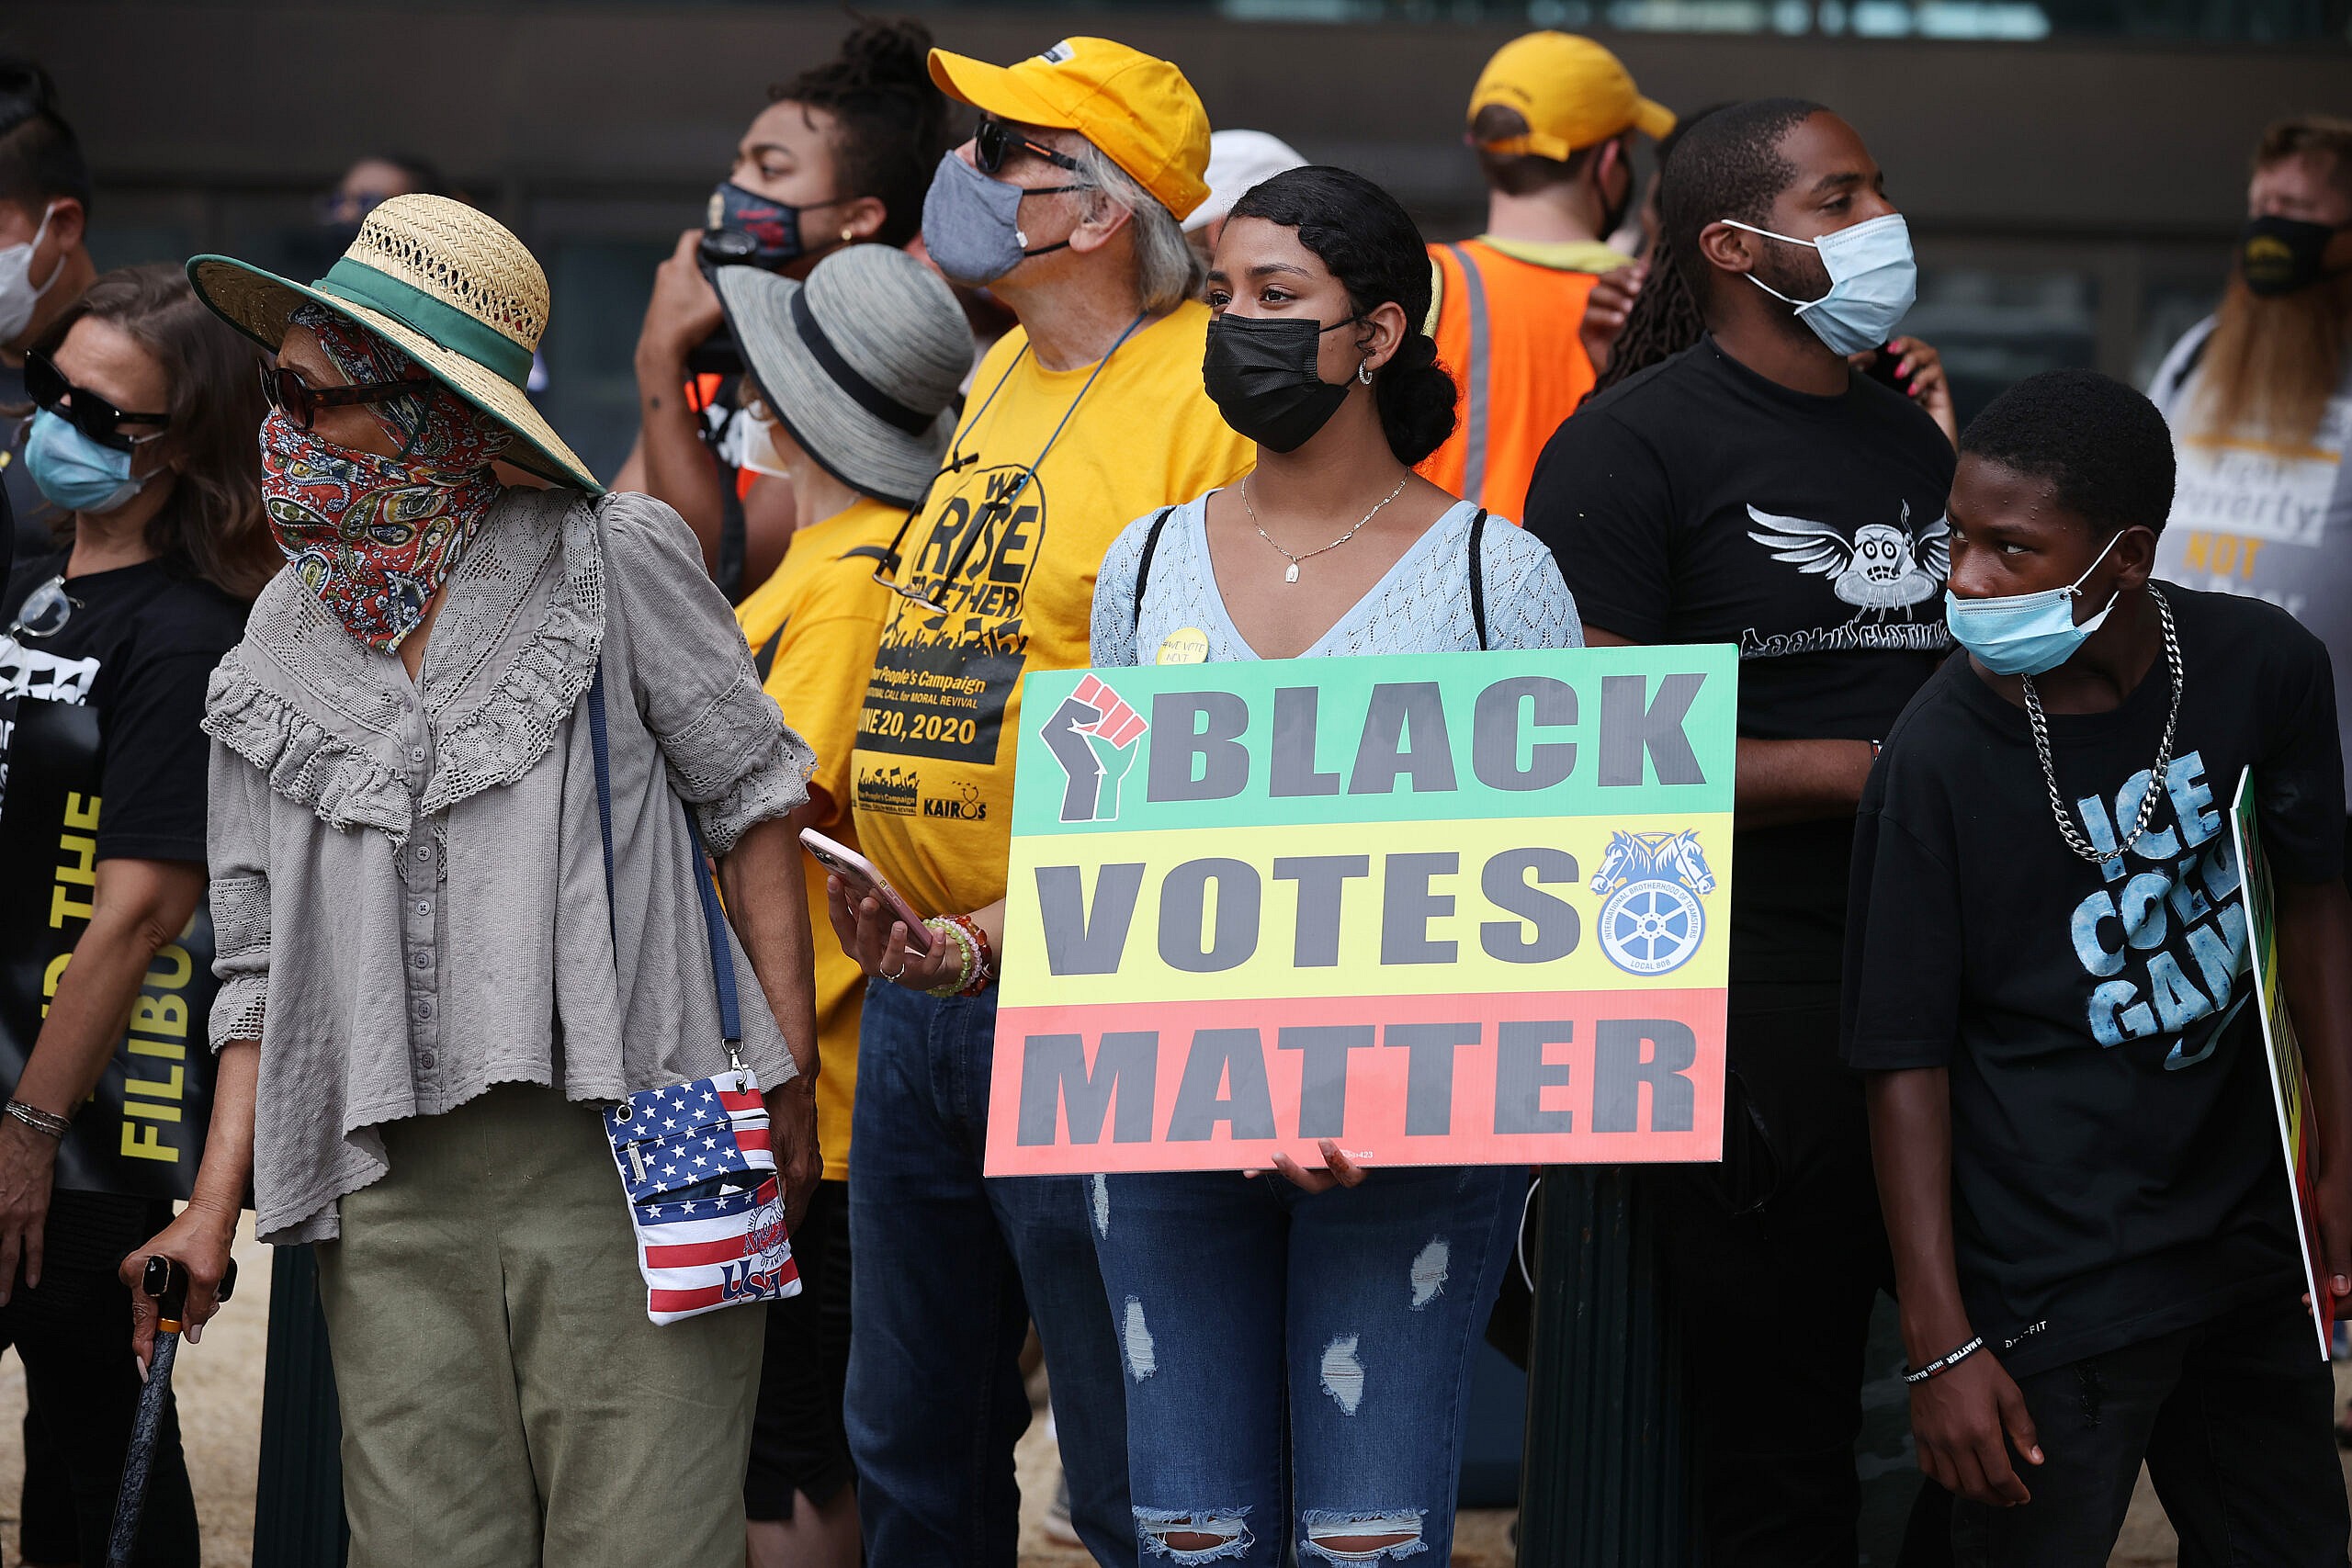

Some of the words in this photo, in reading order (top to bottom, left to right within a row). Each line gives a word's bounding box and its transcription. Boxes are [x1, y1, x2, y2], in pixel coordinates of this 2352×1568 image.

[917, 497, 1039, 583] RISE
[2183, 528, 2265, 581] NOT
[880, 666, 918, 686] People's
[919, 671, 987, 695] Campaign
[884, 690, 899, 701] CALL
[899, 691, 910, 702] for
[910, 693, 938, 705] MORAL
[939, 695, 978, 710] REVIVAL
[877, 709, 908, 742] 20,
[910, 714, 977, 745] 2020
[1147, 673, 1707, 802] BLACK
[2077, 750, 2222, 883] ICE
[50, 791, 102, 930] THE
[1035, 848, 1580, 976] VOTES
[1604, 893, 1629, 940] INTERNATIONAL
[1629, 882, 1679, 896] BROTHERHOOD
[1679, 893, 1688, 902] OF
[1685, 899, 1699, 939] TEAMSTERS
[2071, 830, 2242, 976] COLD
[1630, 959, 1654, 969] LOCAL
[120, 912, 197, 1162] FILIBU
[1017, 1018, 1696, 1146] MATTER
[720, 1258, 781, 1303] USA
[761, 1258, 770, 1268] OF
[1946, 1342, 1976, 1364] MATTER
